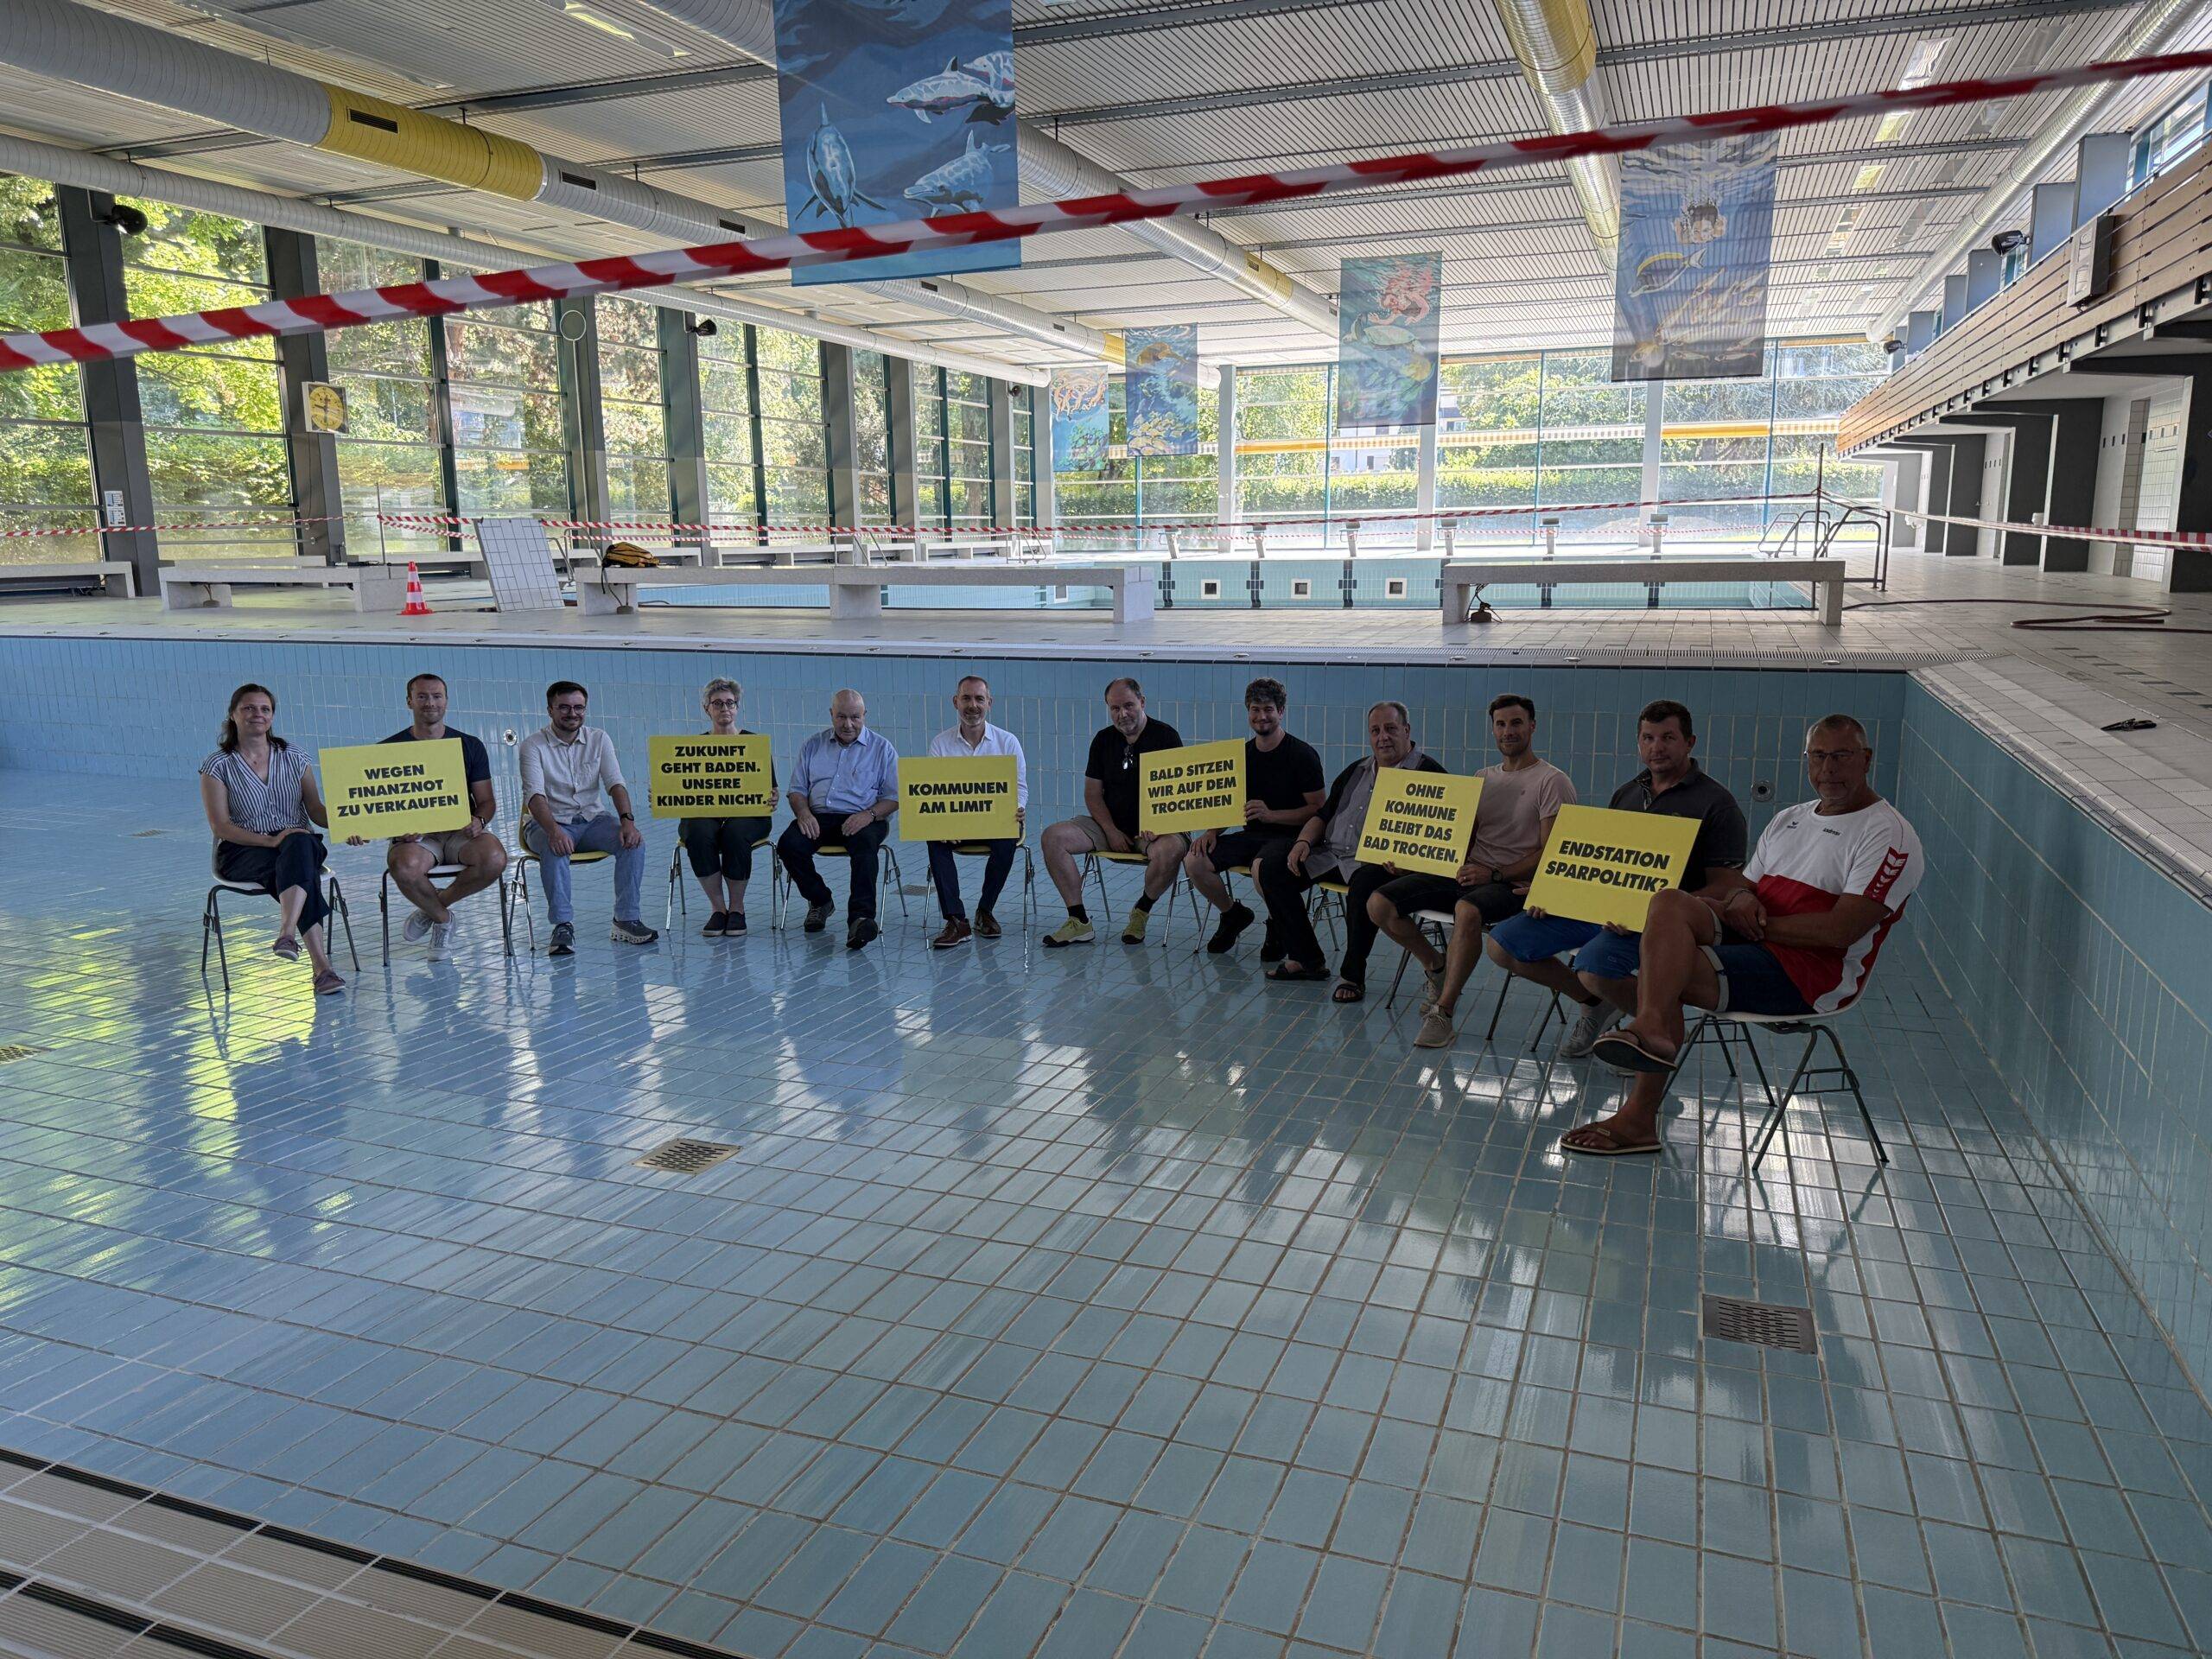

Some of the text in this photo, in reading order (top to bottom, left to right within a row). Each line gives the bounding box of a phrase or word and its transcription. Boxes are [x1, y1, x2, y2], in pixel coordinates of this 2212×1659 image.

[675, 746, 746, 757] ZUKUNFT
[365, 766, 424, 780] WEGEN
[661, 761, 760, 773] GEHT BADEN.
[1150, 760, 1233, 781] BALD SITZEN
[349, 779, 444, 798] FINANZNOT
[683, 779, 741, 790] UNSERE
[909, 782, 1007, 796] KOMMUNEN
[1147, 776, 1236, 798] WIR AUF DEM
[1406, 784, 1445, 799] OHNE
[338, 795, 458, 817] ZU VERKAUFEN
[657, 794, 766, 806] KINDER NICHT.
[919, 800, 993, 813] AM LIMIT
[1152, 794, 1231, 814] TROCKENEN
[1385, 800, 1457, 821] KOMMUNE
[1379, 818, 1452, 841] BLEIBT DAS
[1363, 836, 1459, 863] BAD TROCKEN.
[1559, 841, 1670, 870] ENDSTATION
[1545, 861, 1669, 893] SPARPOLITIK?
